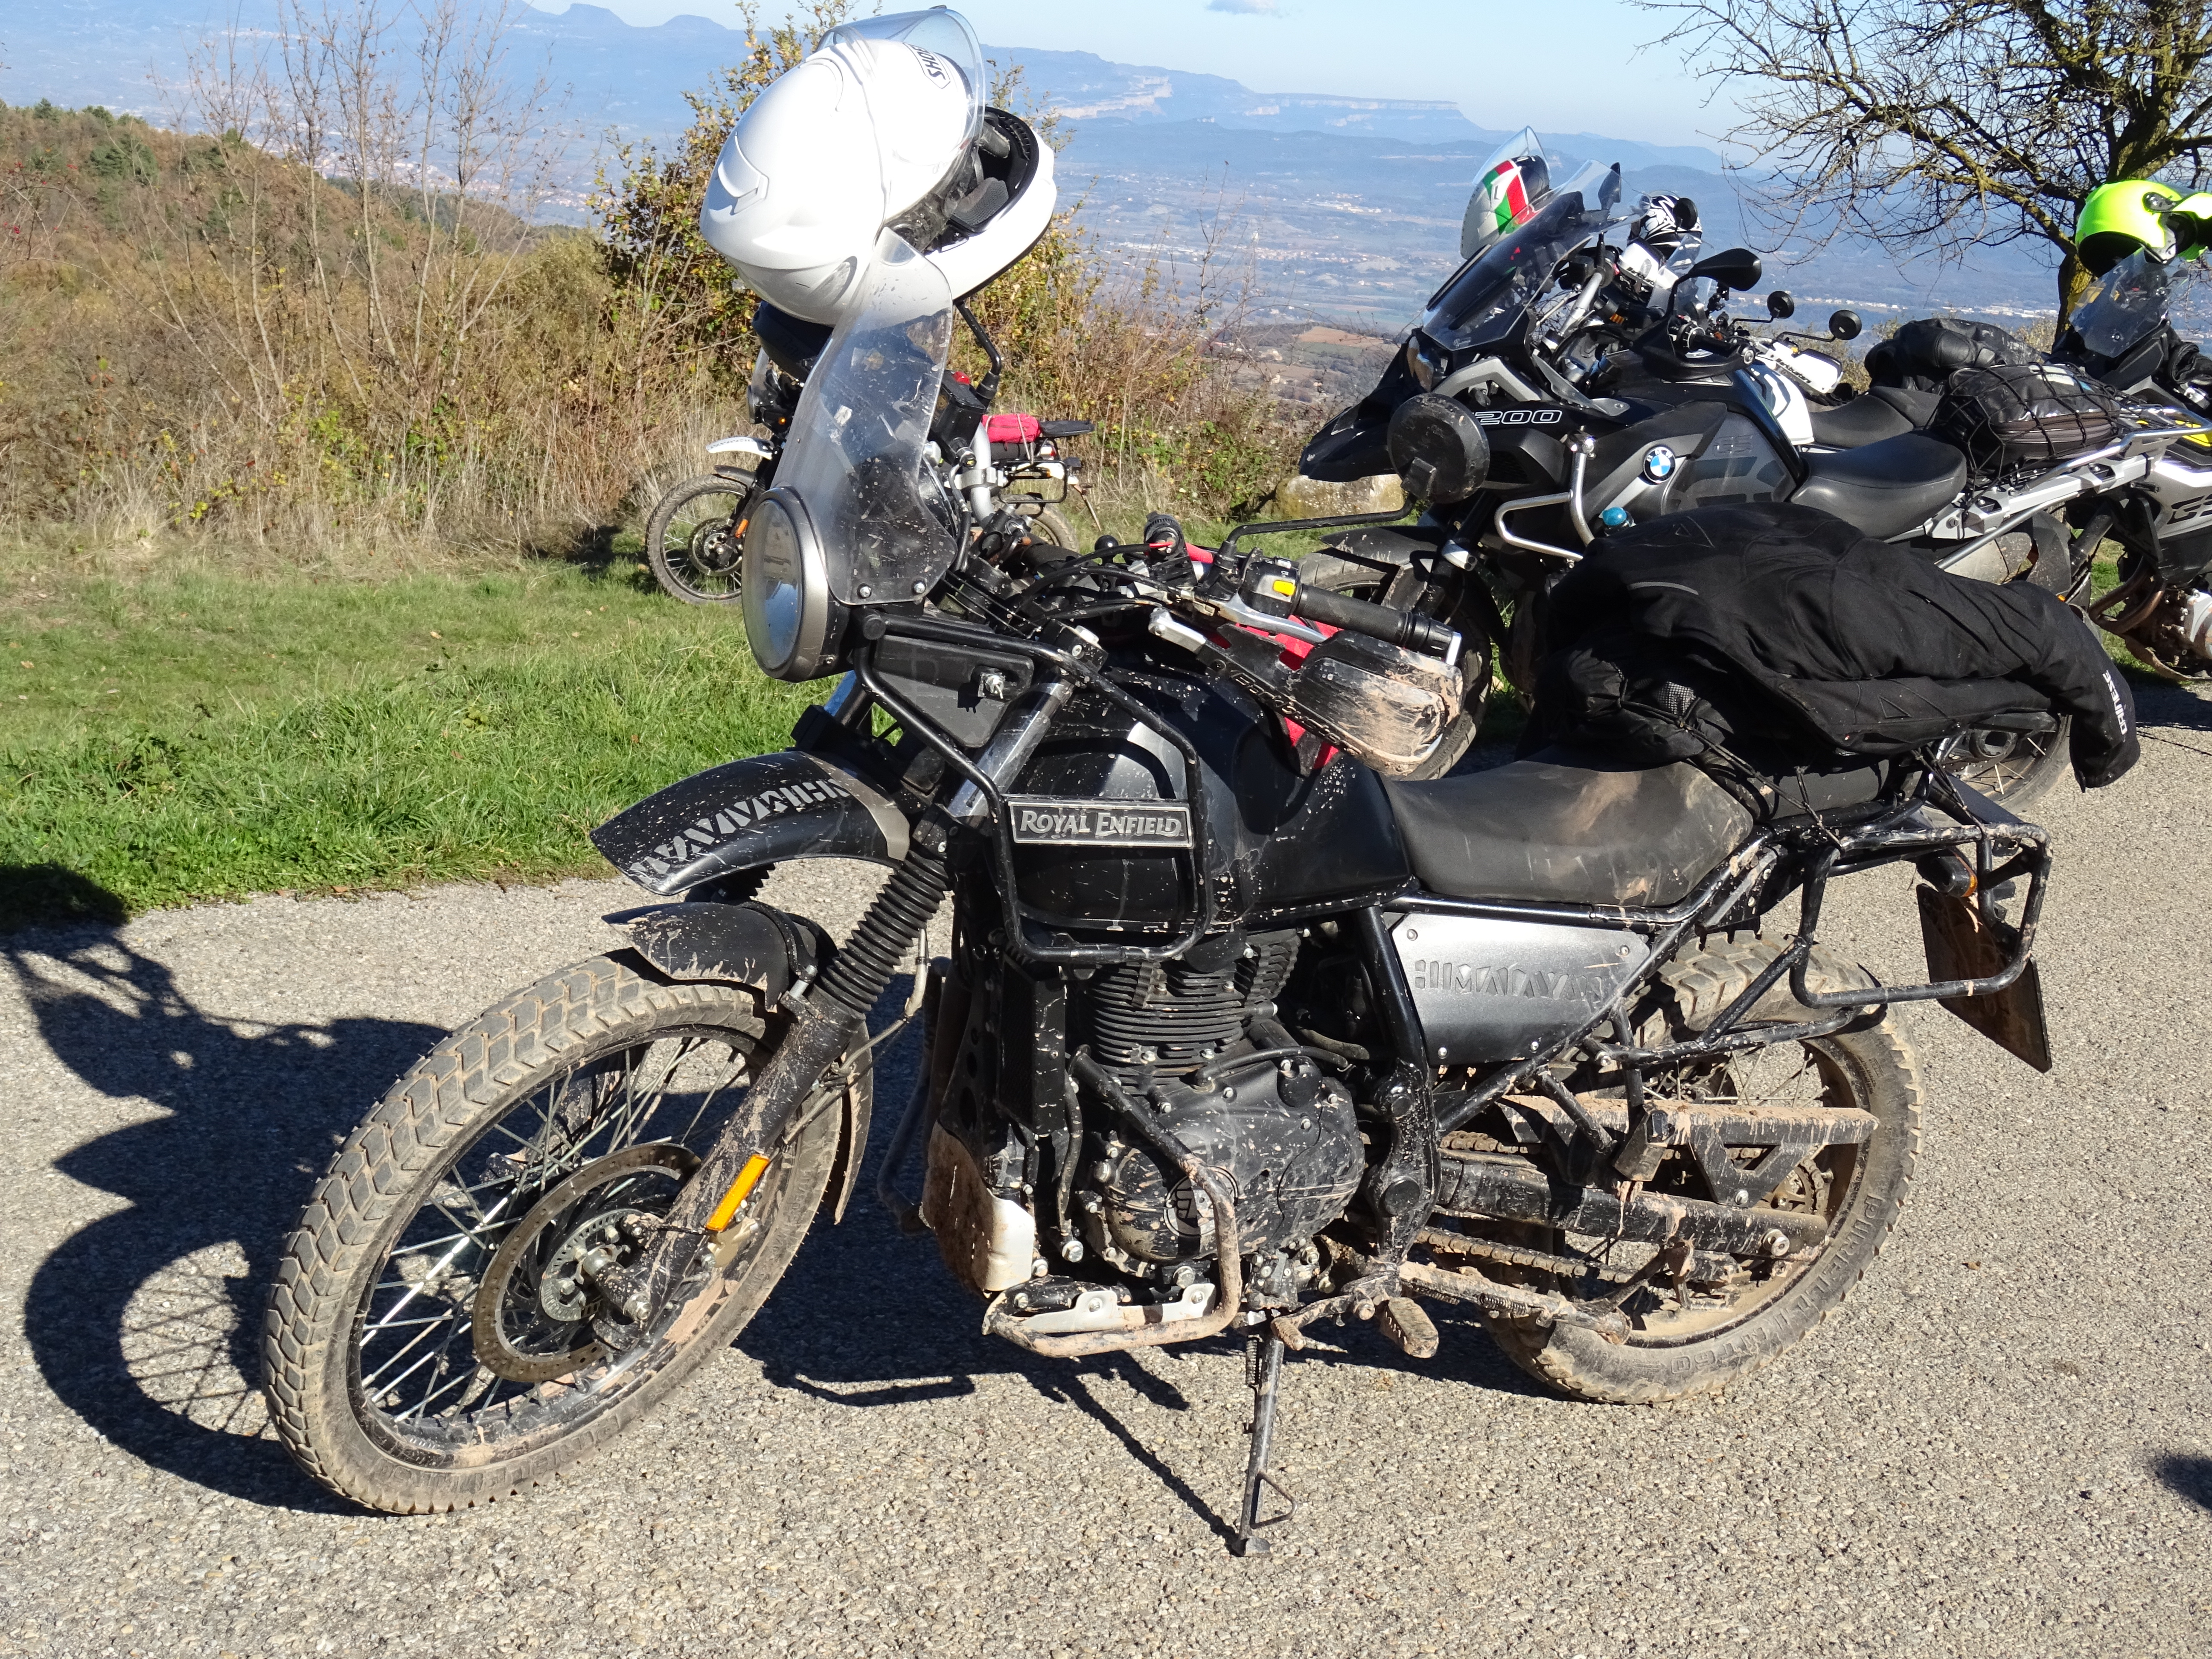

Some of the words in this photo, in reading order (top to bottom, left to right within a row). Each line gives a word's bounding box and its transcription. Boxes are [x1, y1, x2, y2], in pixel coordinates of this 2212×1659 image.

[1472, 410, 1563, 425] 200
[2102, 670, 2128, 735] DAINESE
[1020, 811, 1090, 833] ROYAL
[1095, 812, 1182, 836] ENFIELD
